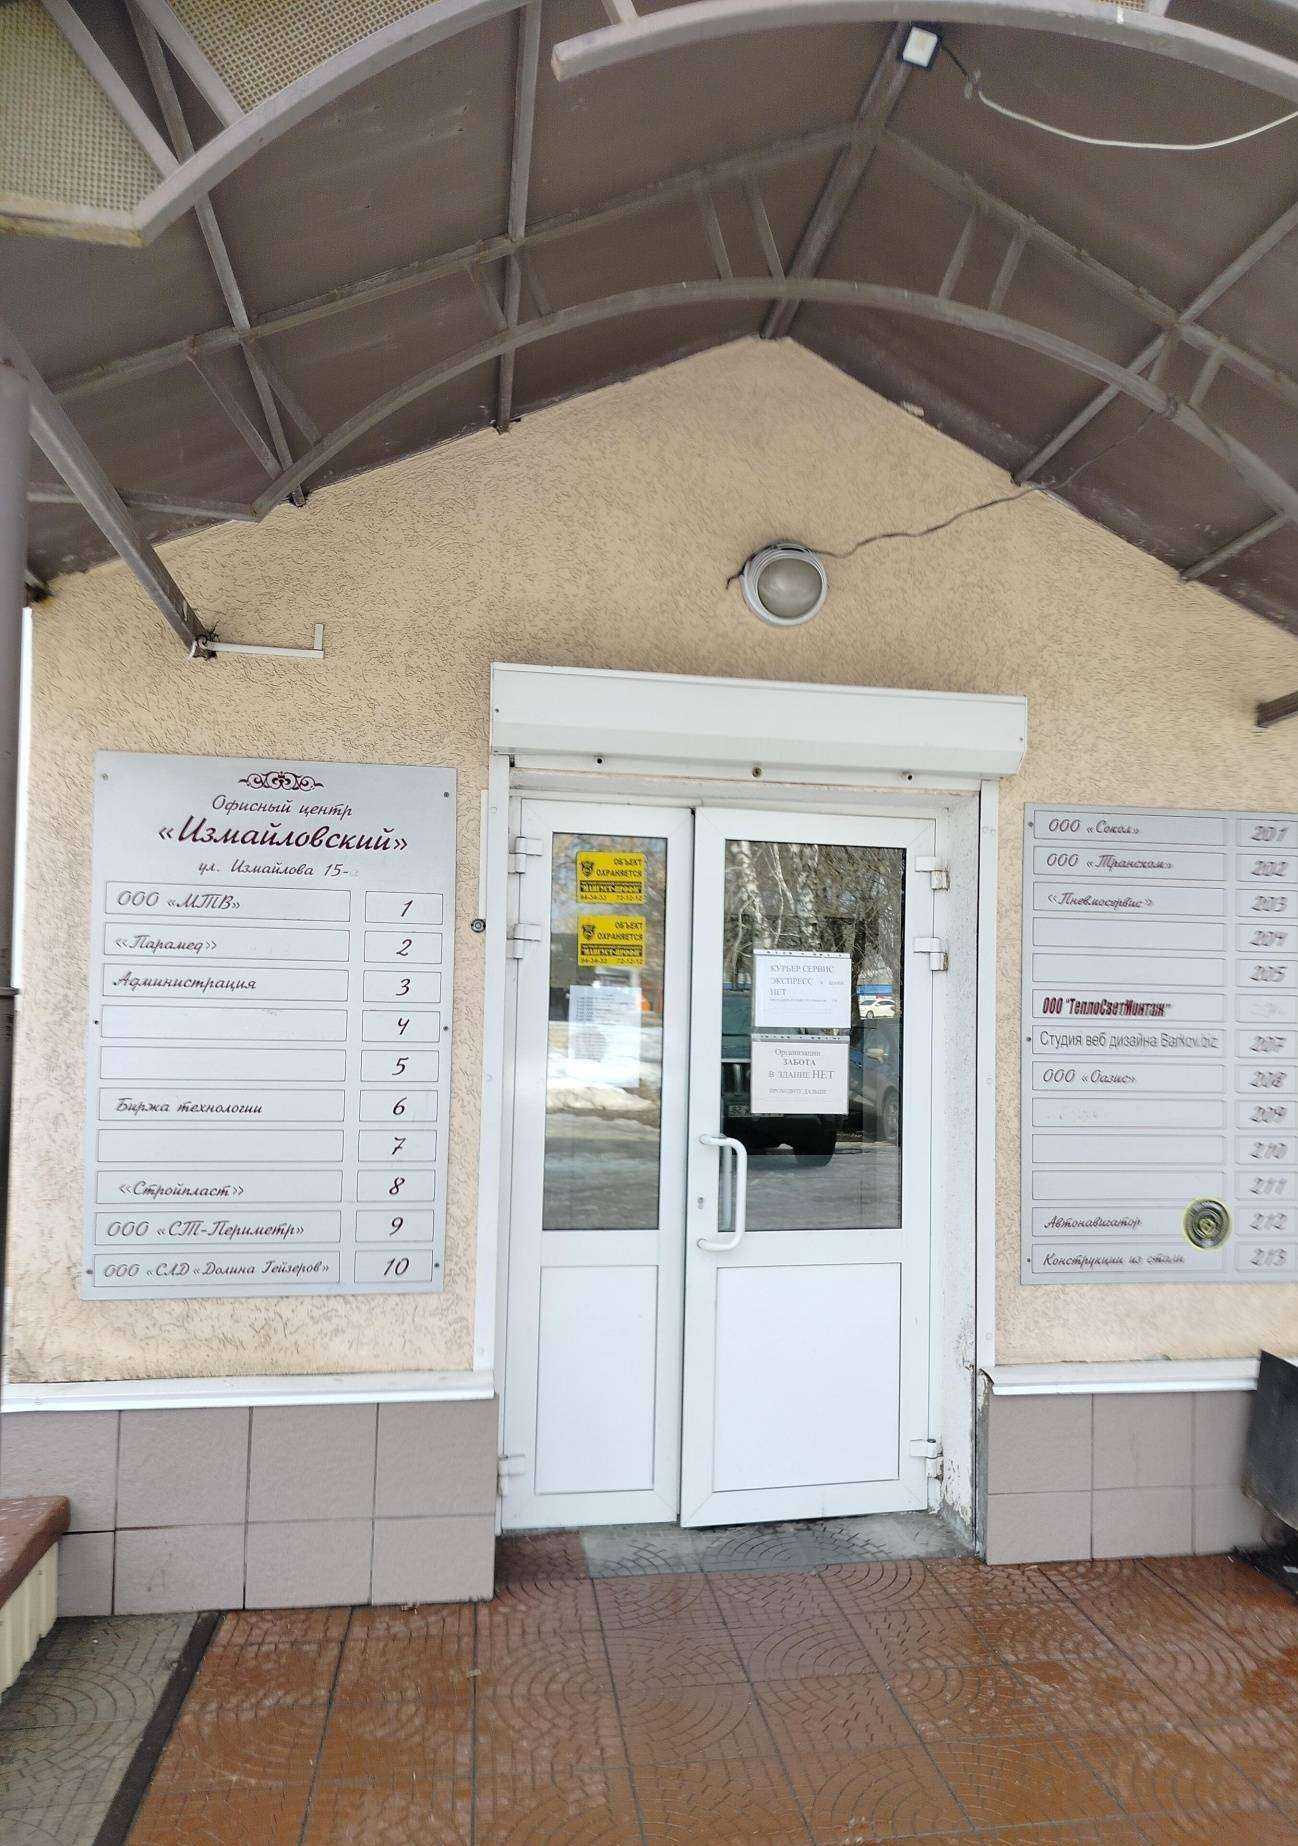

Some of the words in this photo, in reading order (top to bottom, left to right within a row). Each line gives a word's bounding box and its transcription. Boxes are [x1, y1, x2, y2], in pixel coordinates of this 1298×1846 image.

[212, 794, 292, 816] Офисный
[299, 801, 352, 818] центр
[158, 815, 408, 852] «Измайловский»
[1049, 818, 1081, 833] ООО
[1086, 820, 1140, 835] «Сокол»
[1250, 825, 1289, 842] 201
[198, 862, 220, 874] ул.
[230, 859, 314, 876] Измайлова
[1047, 853, 1079, 868] ООО
[1251, 860, 1289, 877] 202
[117, 890, 159, 907] ООО
[167, 893, 241, 911] «МТВ»
[401, 900, 413, 918] 1
[1047, 892, 1153, 910] «Пневмосервис»
[1251, 895, 1288, 912] 203
[115, 934, 217, 956] «Парамед»
[396, 939, 413, 957] 2
[770, 965, 802, 975] КУРЬЕР
[802, 966, 834, 975] СЕРВИС
[1250, 966, 1287, 983] 205
[113, 970, 257, 991] Администрация
[396, 978, 410, 996] 3
[769, 977, 814, 987] ЭКСПРЕСС
[769, 988, 788, 997] НЕТ
[1042, 997, 1064, 1014] ООО
[396, 1017, 411, 1036] 4
[1040, 1031, 1083, 1049] Студия
[1085, 1032, 1106, 1047] веб
[1109, 1033, 1158, 1049] дизайна
[392, 1056, 409, 1076] 5
[783, 1058, 816, 1067] ЗАБОТА
[812, 1070, 835, 1080] НЕТ
[1043, 1069, 1075, 1082] ООО
[1081, 1068, 1136, 1083] «Оазис»
[116, 1097, 169, 1116] Биржа
[176, 1101, 263, 1115] технологии
[392, 1097, 406, 1116] 6
[391, 1137, 407, 1155] 7
[118, 1179, 244, 1198] «Стройпласт»
[388, 1177, 405, 1195] 8
[107, 1221, 150, 1238] ООО
[157, 1220, 305, 1241] «СТ-Периметр»
[390, 1216, 404, 1236] 9
[1044, 1216, 1142, 1229] Автонавигатор
[103, 1264, 140, 1278] ООО
[193, 1261, 255, 1276] «Долина
[265, 1259, 329, 1276] Гейзеров»
[383, 1257, 410, 1276] 10
[1042, 1253, 1124, 1270] Конструкции
[1128, 1256, 1142, 1265] из
